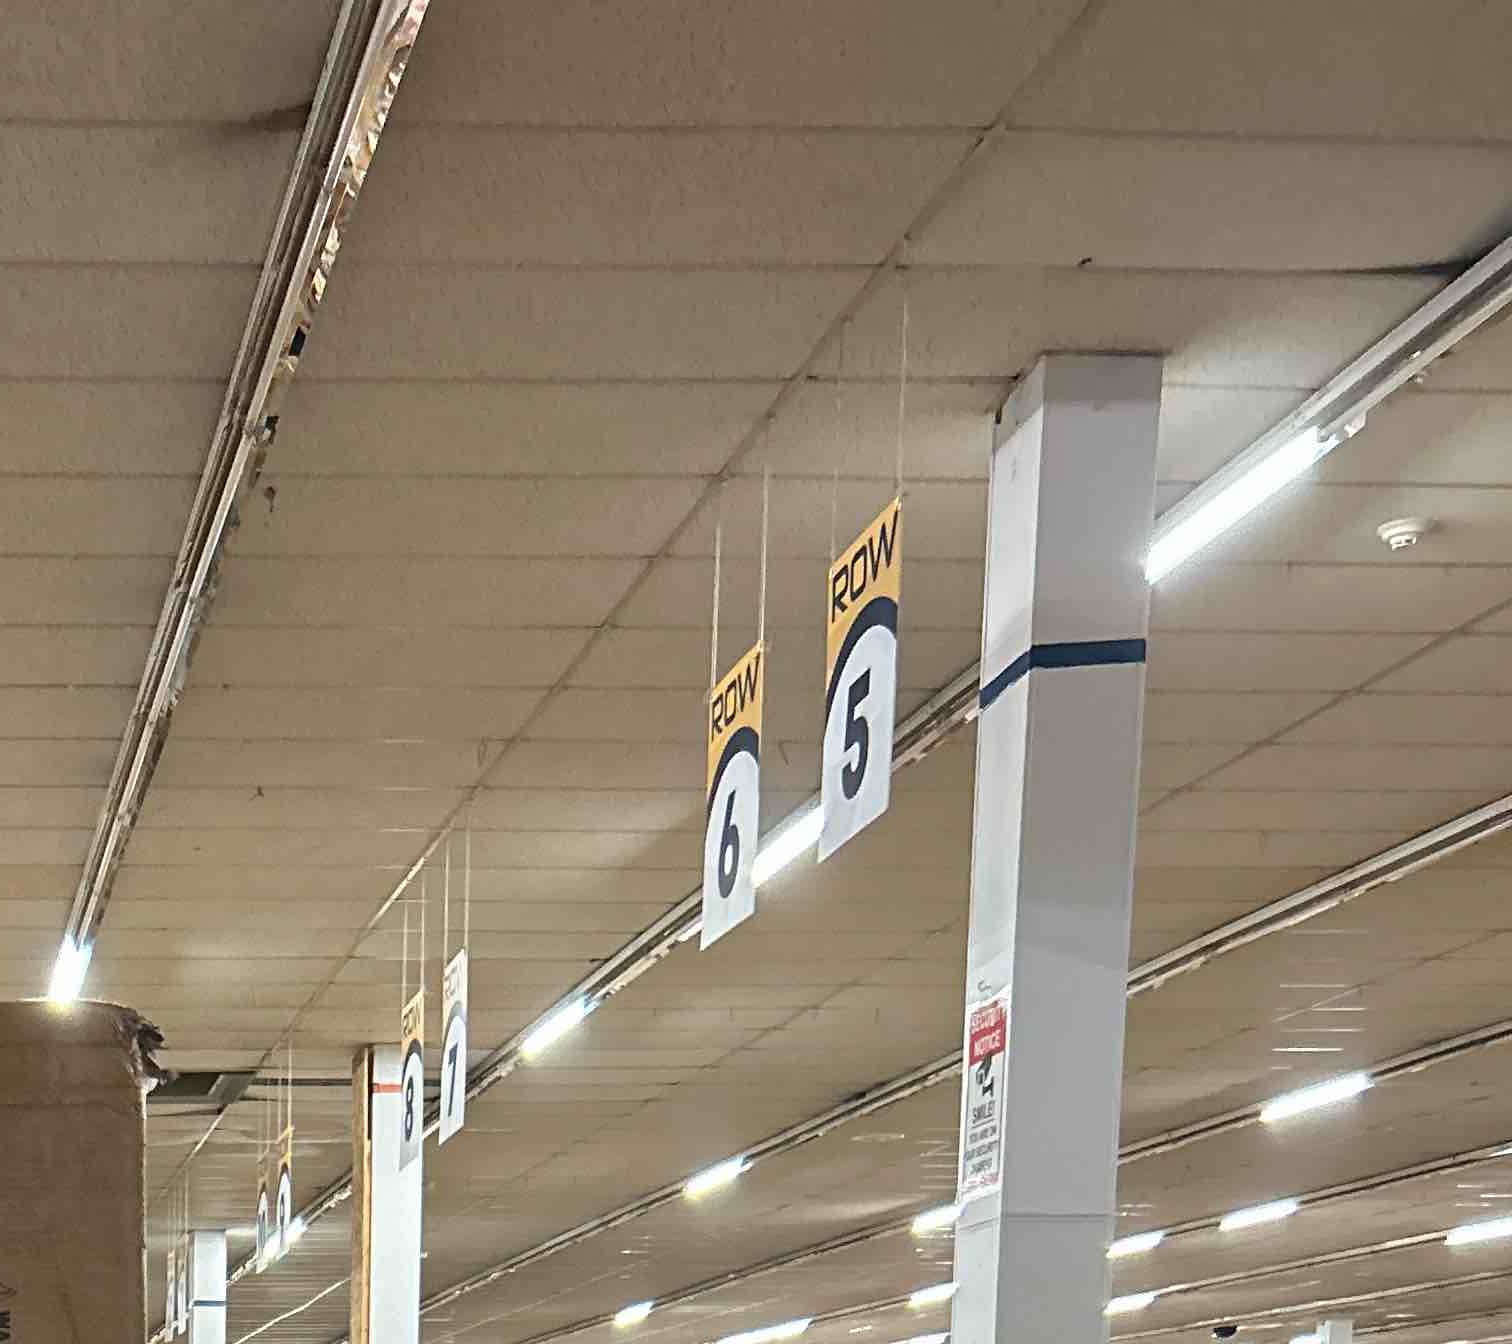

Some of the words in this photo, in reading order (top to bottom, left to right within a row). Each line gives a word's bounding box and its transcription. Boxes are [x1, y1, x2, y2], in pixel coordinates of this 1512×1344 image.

[830, 511, 899, 622] ROW
[711, 653, 760, 741] ROW
[841, 667, 871, 801] 5
[718, 789, 740, 899] 6
[404, 1075, 414, 1142] 8
